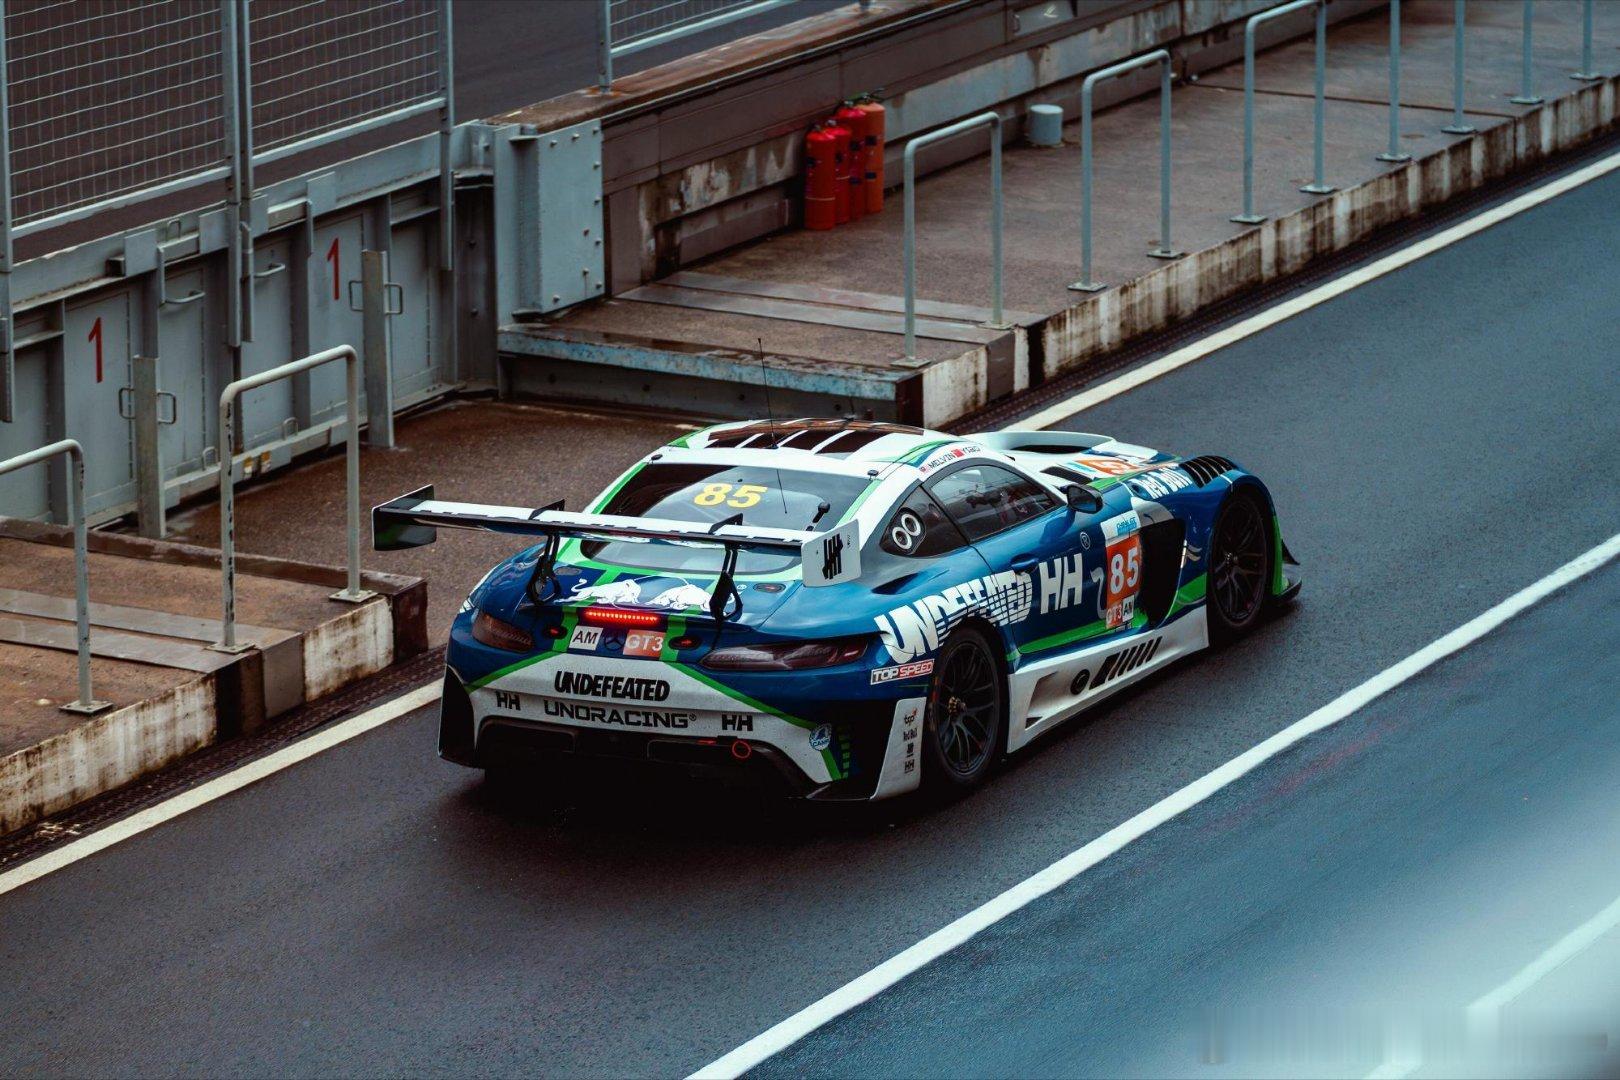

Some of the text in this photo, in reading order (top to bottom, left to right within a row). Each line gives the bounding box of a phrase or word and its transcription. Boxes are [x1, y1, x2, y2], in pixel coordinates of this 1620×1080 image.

[326, 237, 340, 300] 1
[88, 317, 103, 383] 1
[693, 482, 768, 508] 85
[1038, 553, 1083, 614] HH
[1110, 547, 1138, 594] 85
[874, 570, 1033, 664] UNDEFEATED
[572, 630, 598, 645] AM
[625, 634, 663, 651] GT3
[554, 670, 671, 702] UNDEFEATED
[873, 661, 934, 682] TOP SPEED
[495, 690, 521, 711] HH
[721, 713, 754, 732] HH
